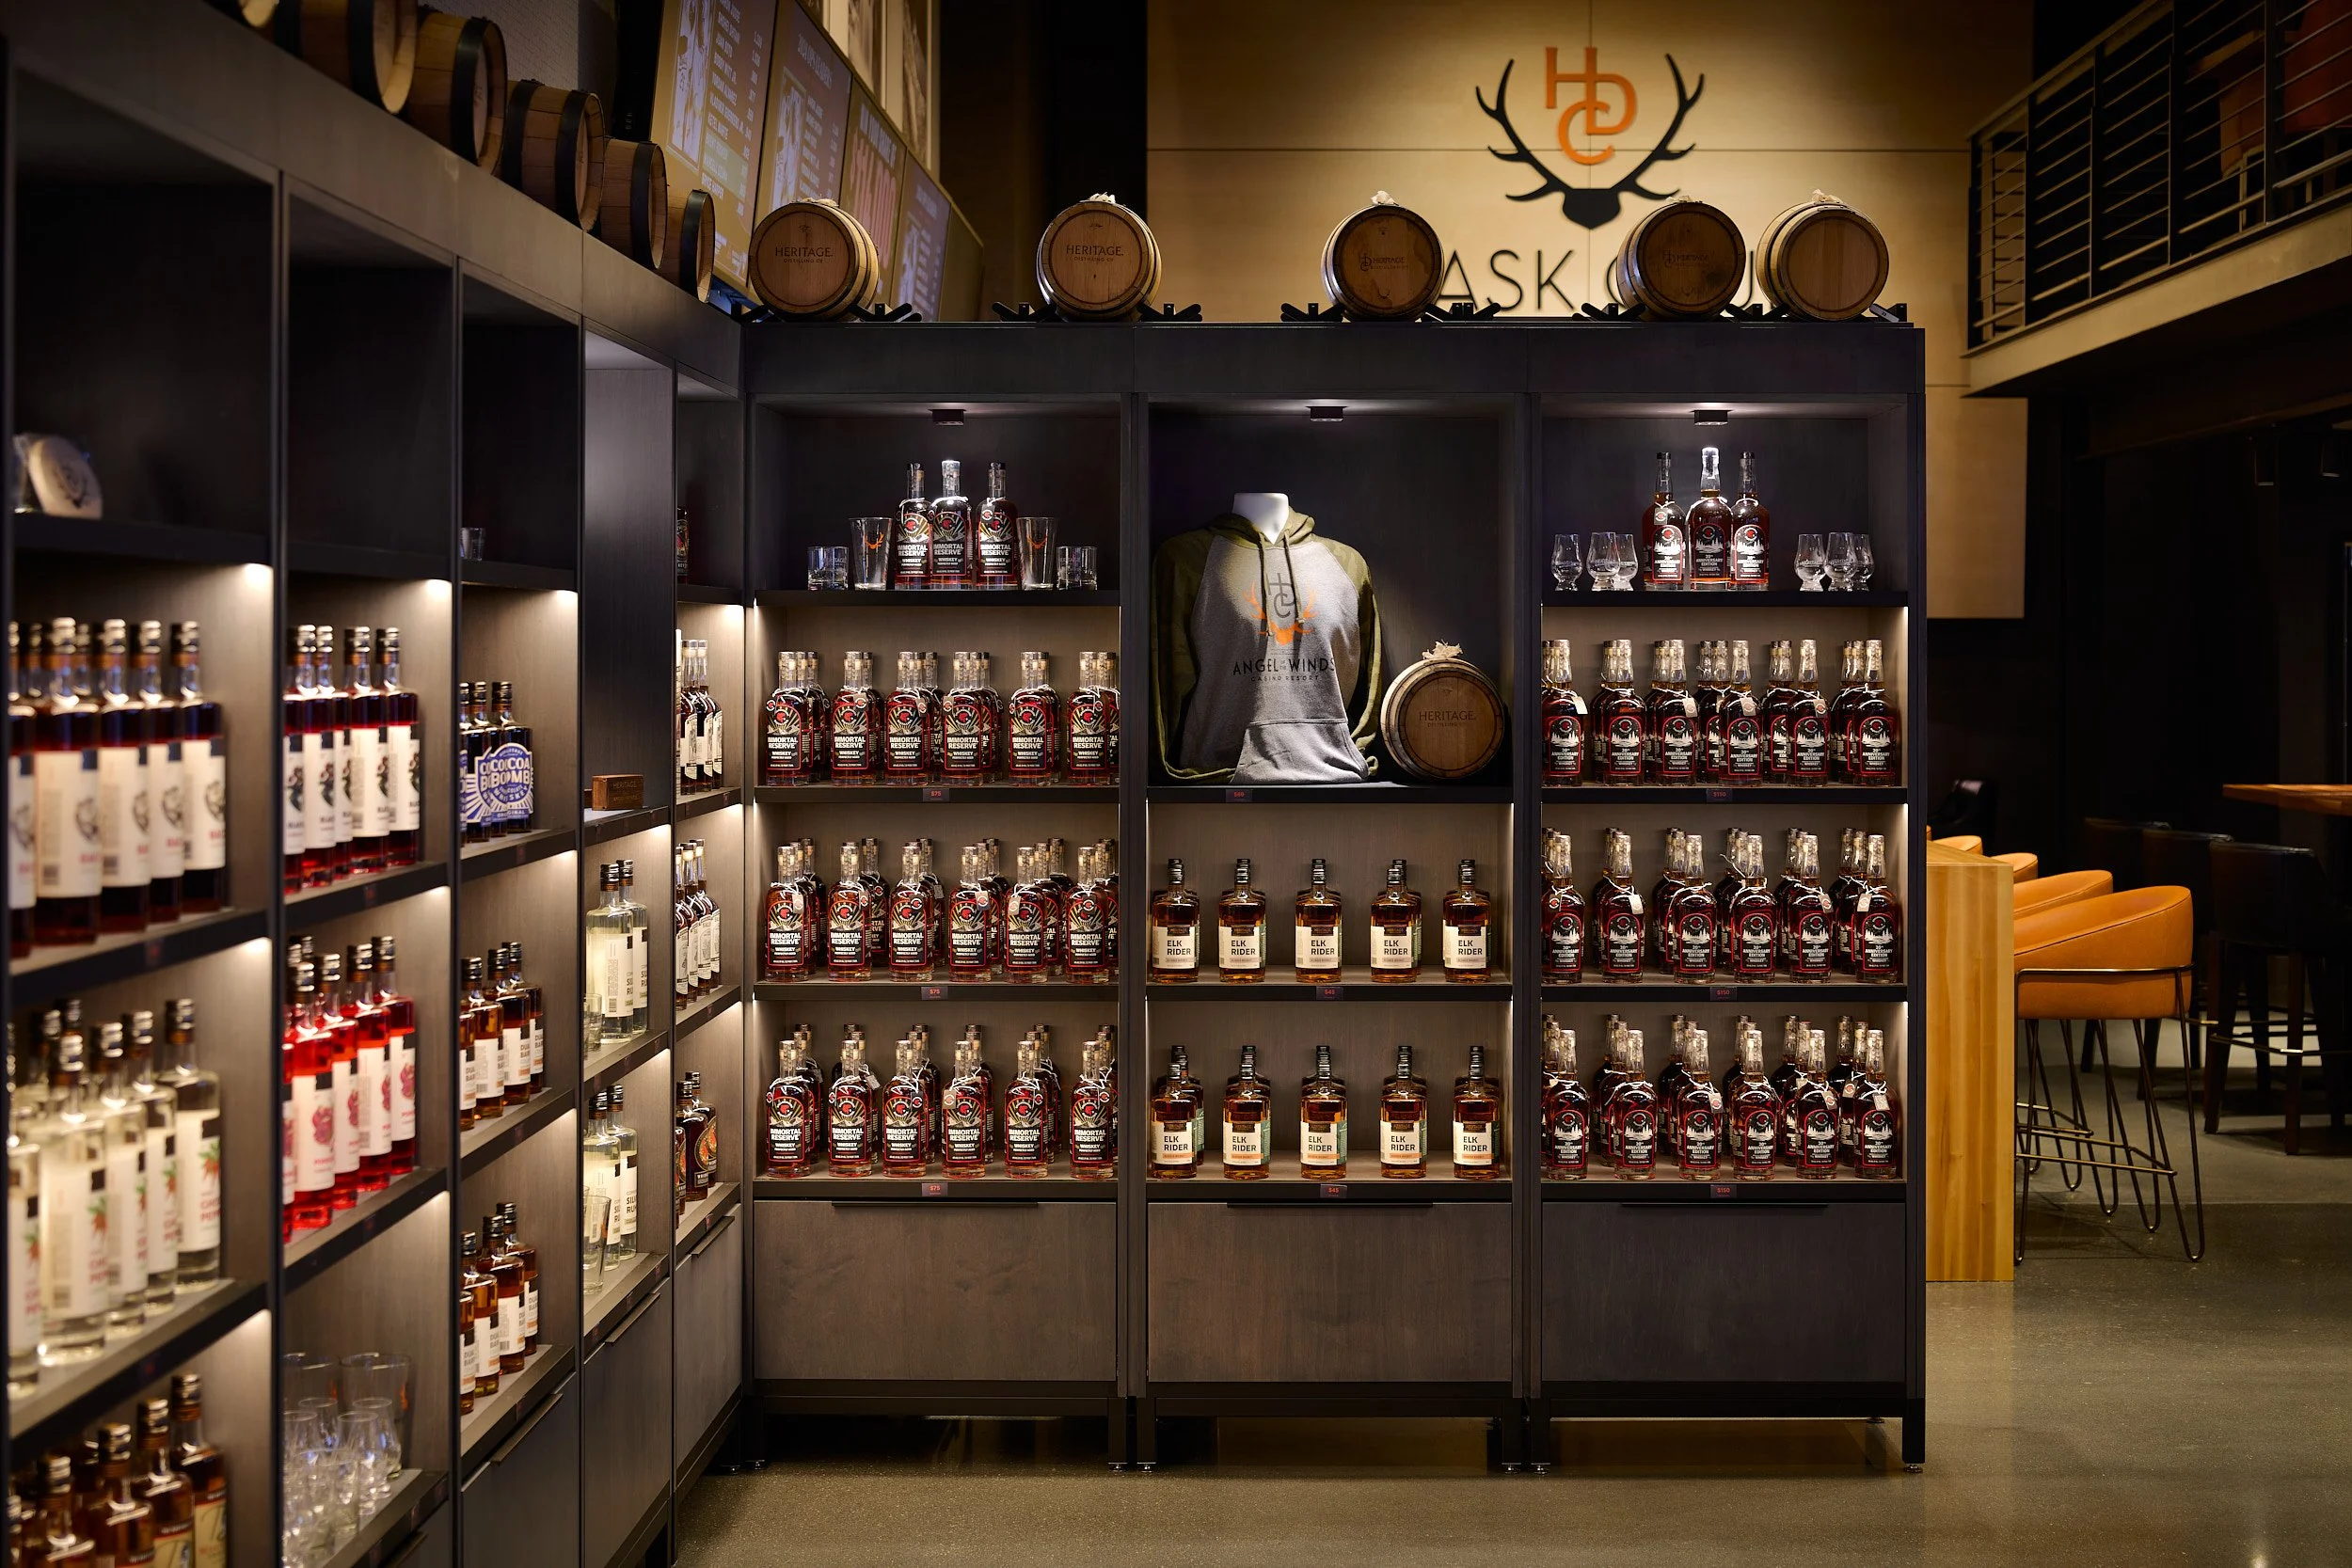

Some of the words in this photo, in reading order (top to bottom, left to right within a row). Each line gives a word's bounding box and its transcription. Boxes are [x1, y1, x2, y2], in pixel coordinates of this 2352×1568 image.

[775, 246, 832, 257] HERITAGE
[1066, 245, 1122, 257] HERITAGE
[1438, 248, 1575, 310] ASK
[1232, 657, 1279, 676] ANGEL
[1288, 657, 1335, 673] WINDS
[1419, 710, 1474, 721] HERITAGE
[627, 1205, 637, 1213] RU
